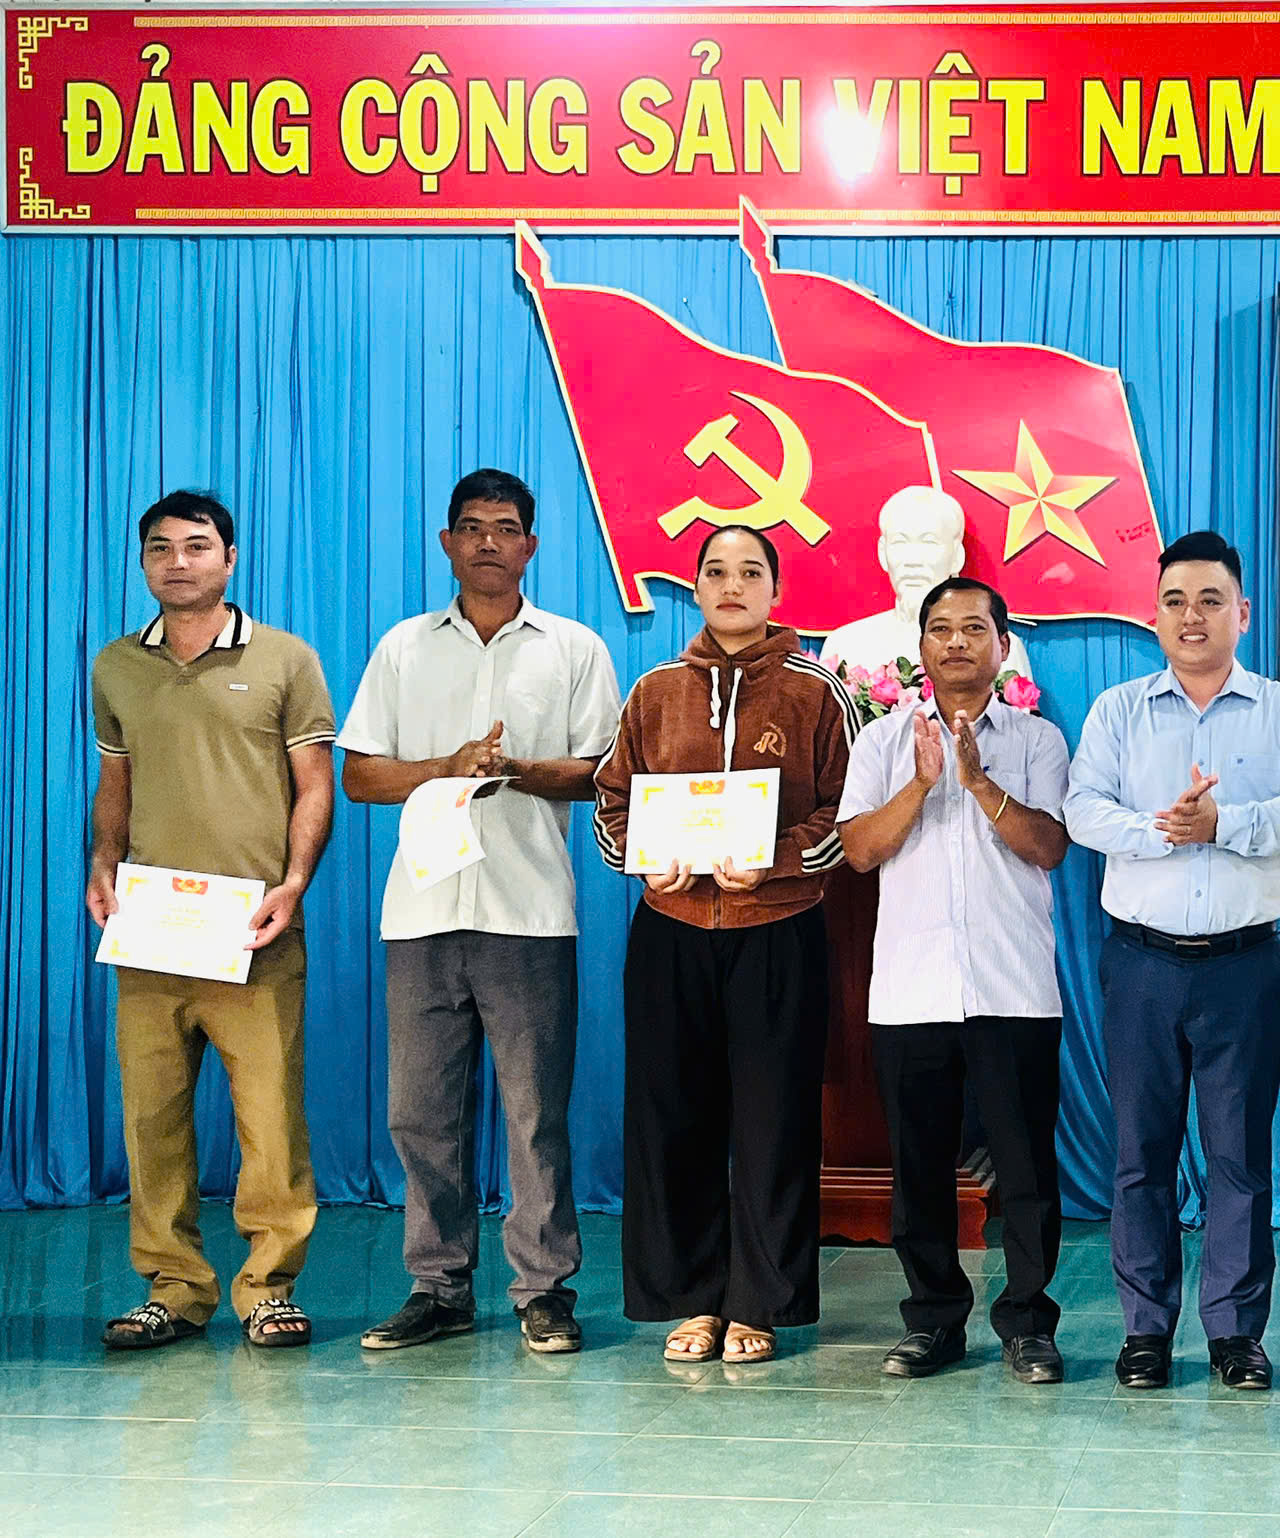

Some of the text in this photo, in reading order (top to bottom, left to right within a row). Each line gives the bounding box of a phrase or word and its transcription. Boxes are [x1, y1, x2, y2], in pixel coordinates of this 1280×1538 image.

[62, 42, 311, 174] ĐẢNG
[338, 52, 589, 194] CỘNG
[616, 40, 801, 174] SẢN
[832, 50, 1046, 196] VIỆT
